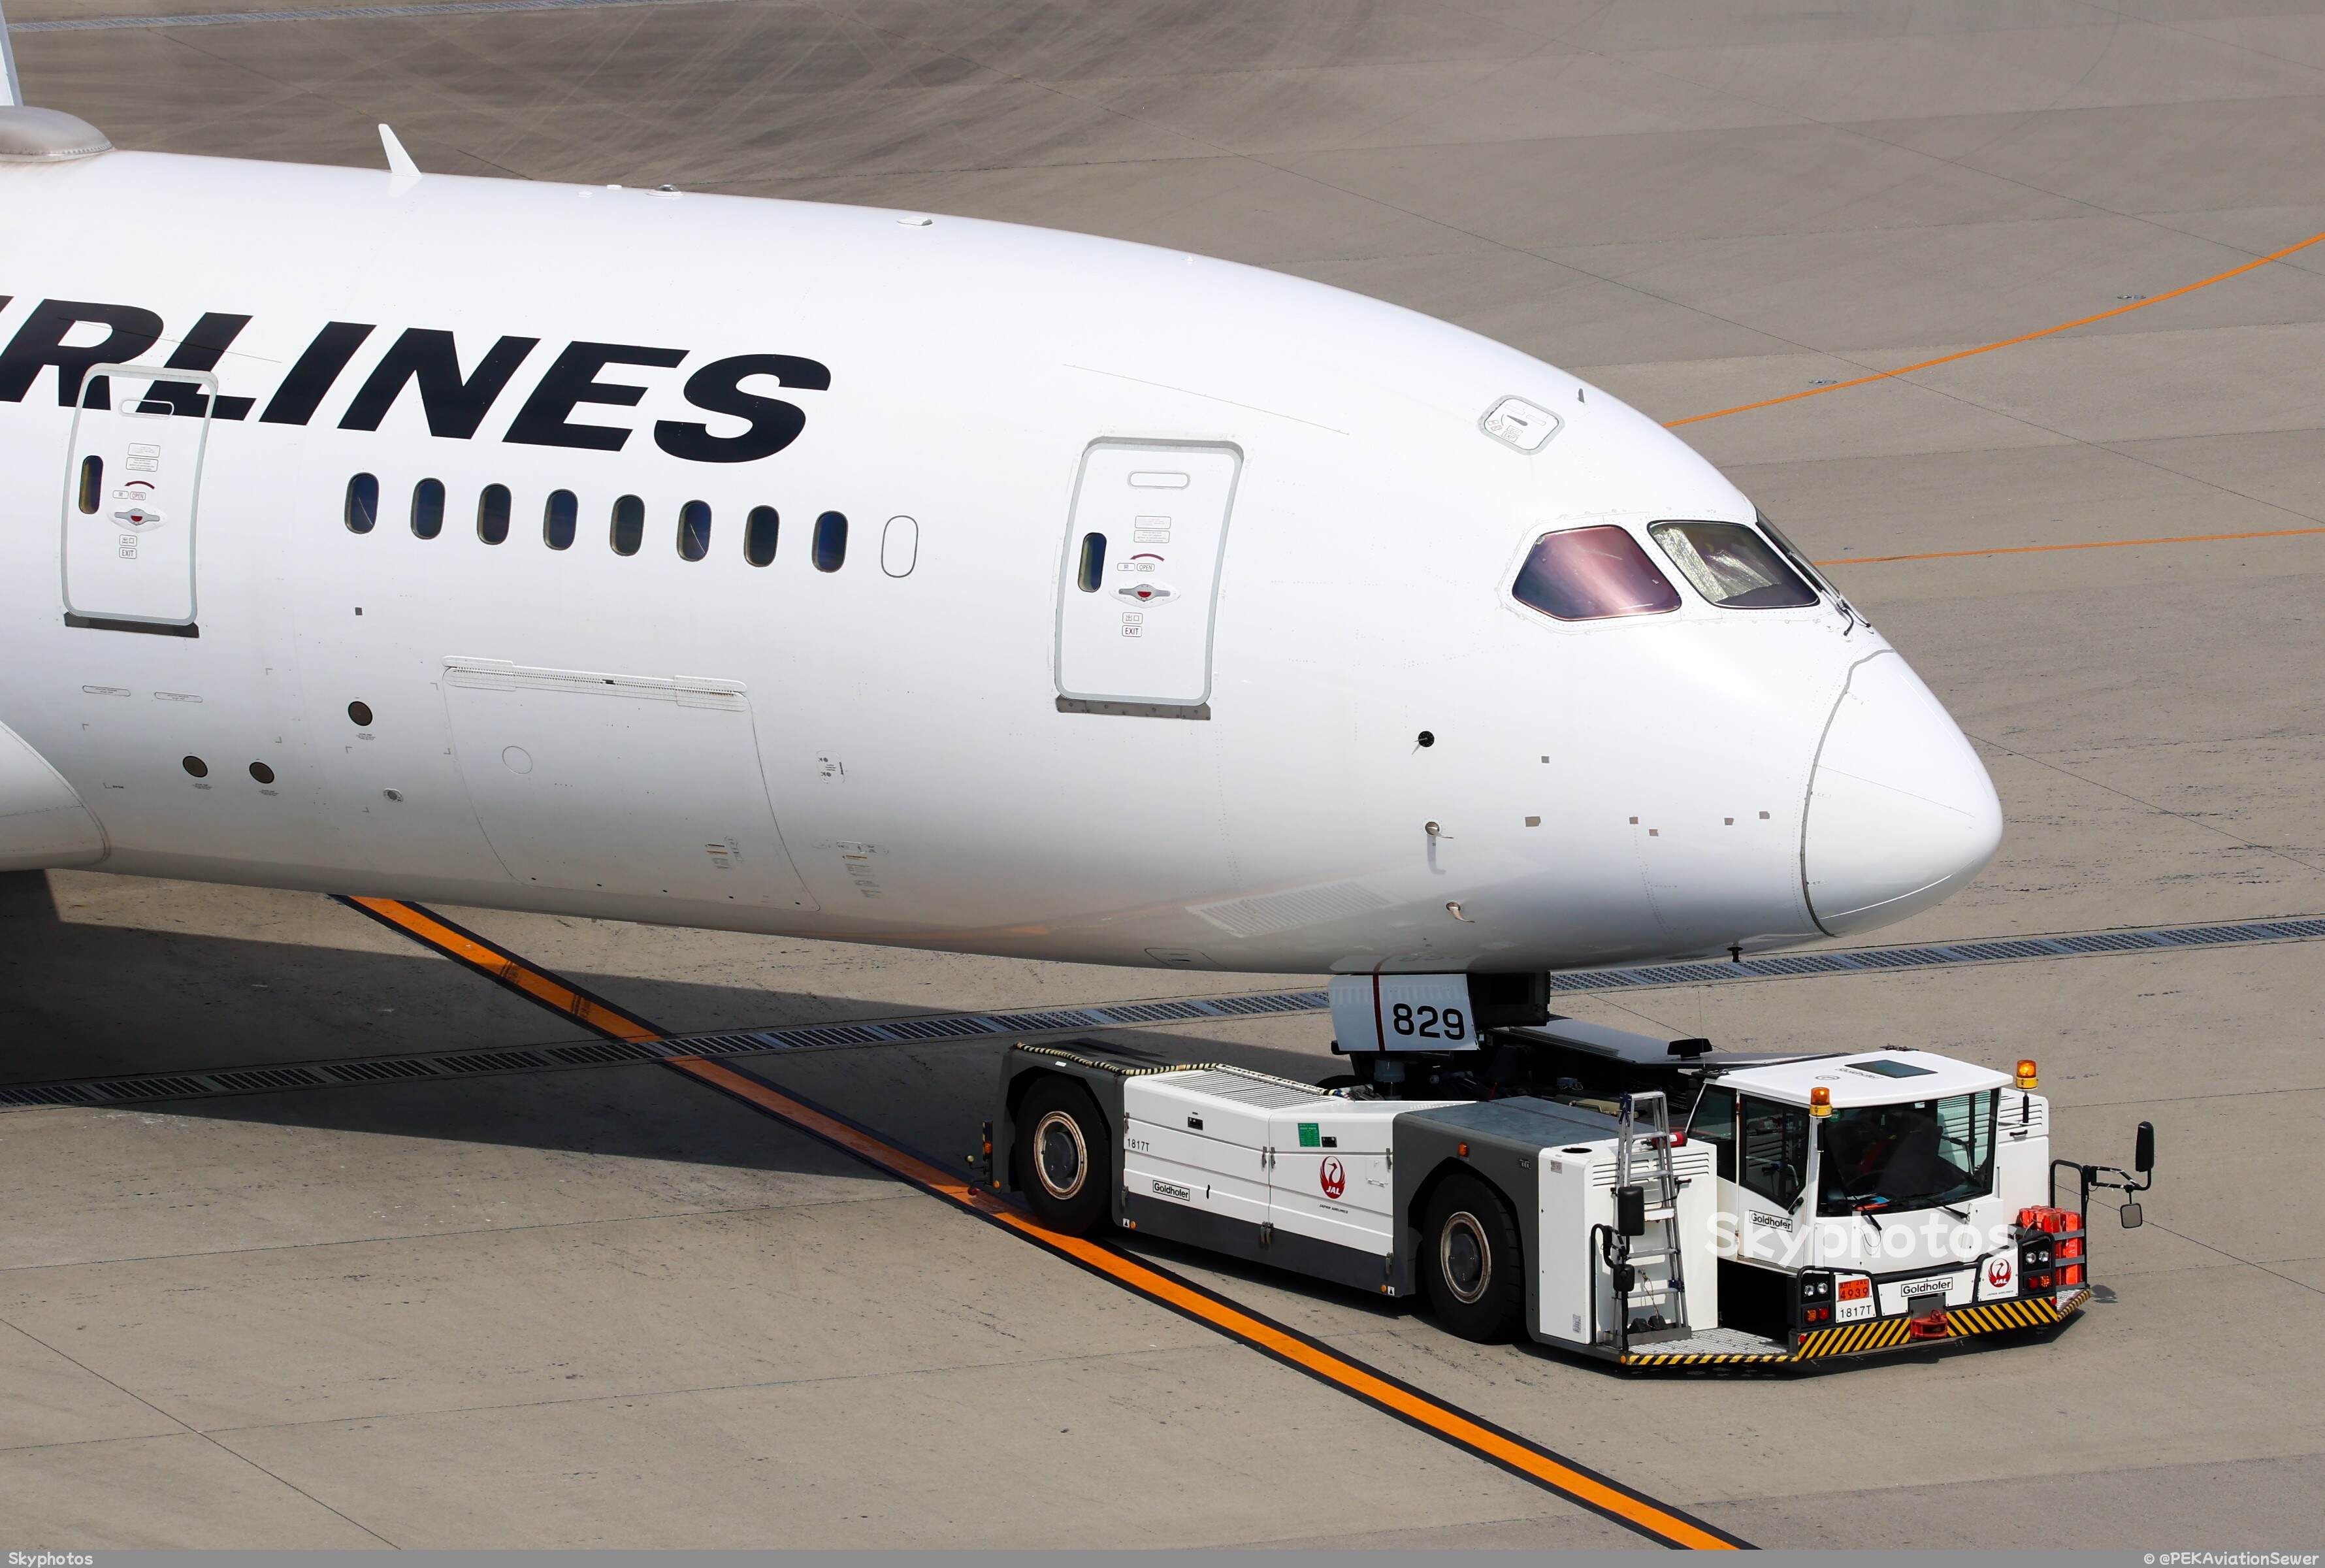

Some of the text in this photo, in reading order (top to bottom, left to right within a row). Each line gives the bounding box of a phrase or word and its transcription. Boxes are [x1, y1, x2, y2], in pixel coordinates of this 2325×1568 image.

[0, 295, 831, 463] RLINES
[122, 549, 134, 557] EXIT
[1125, 627, 1139, 636] EXIT
[1393, 1003, 1465, 1041] 829
[1128, 1138, 1150, 1152] 1817T
[1154, 1183, 1188, 1198] Goldhofer
[1326, 1186, 1341, 1195] JAL
[1751, 1213, 1791, 1230] Goldhofer
[1840, 1287, 1868, 1299] 4939
[1903, 1280, 1951, 1295] Goldhofer
[1840, 1305, 1872, 1318] 1817T
